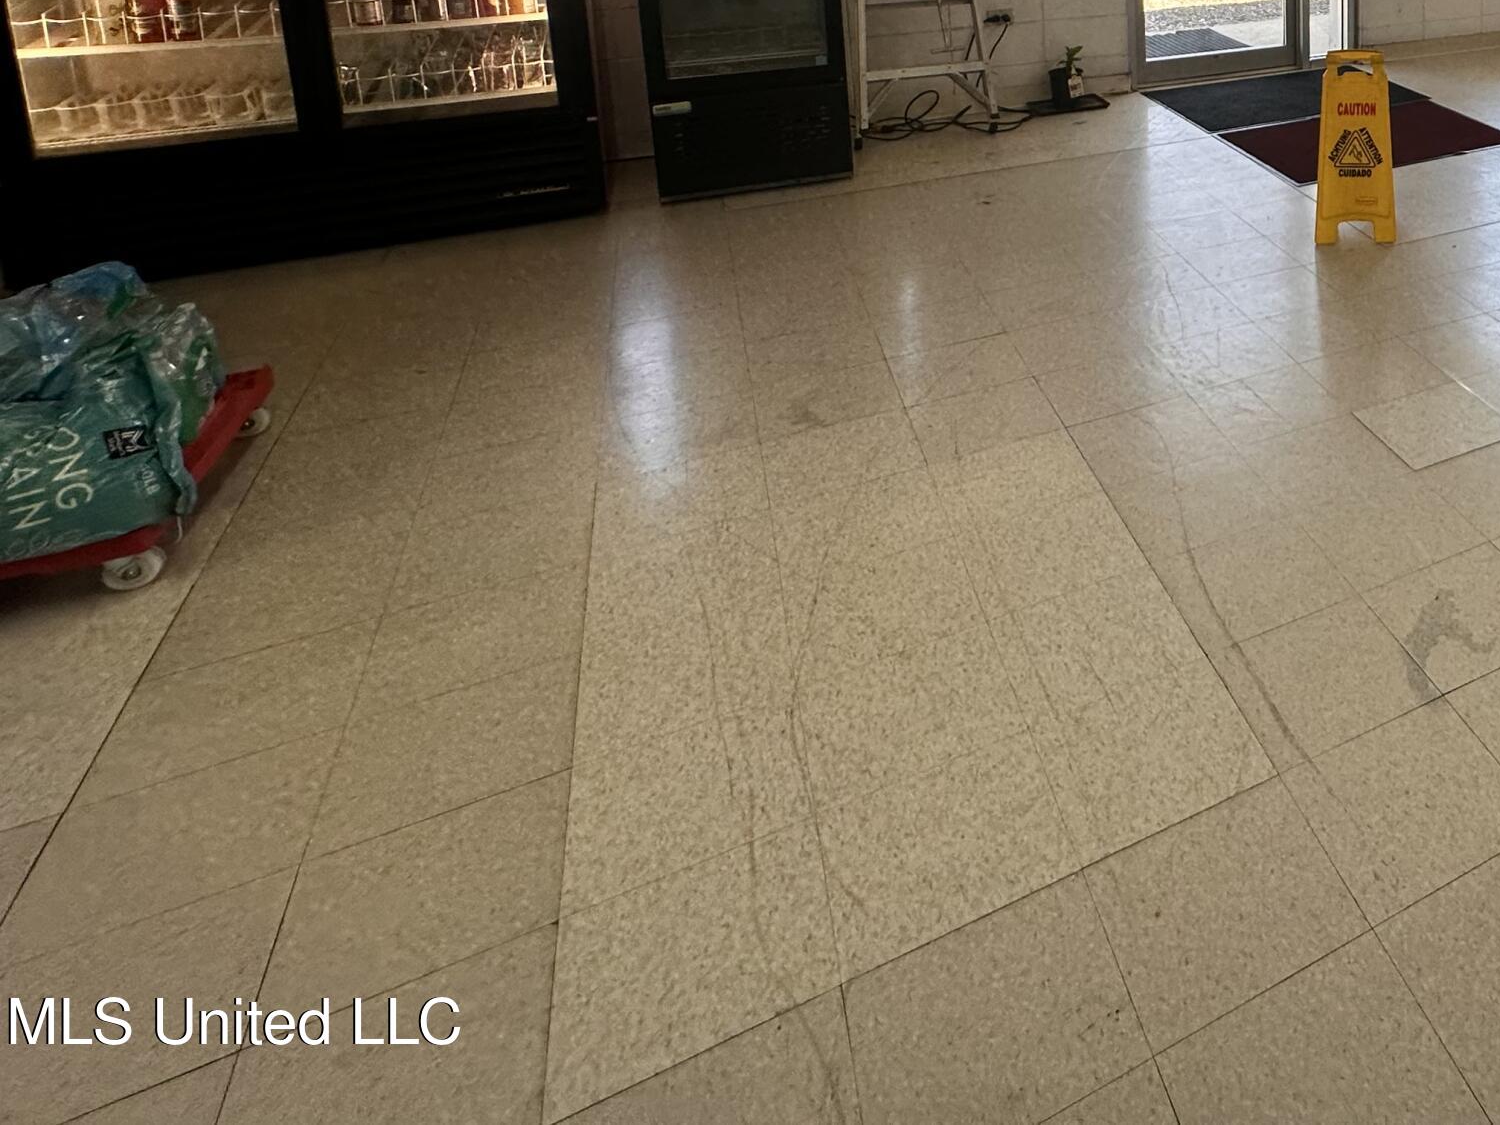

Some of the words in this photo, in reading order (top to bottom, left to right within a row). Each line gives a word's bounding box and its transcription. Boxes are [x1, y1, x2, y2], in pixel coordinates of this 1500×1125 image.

[1337, 102, 1376, 116] CAUTION
[1328, 129, 1351, 163] ACHTUNG
[1359, 127, 1384, 165] ATTENTION
[1338, 168, 1372, 178] CUIDADO
[47, 427, 94, 509] ONG
